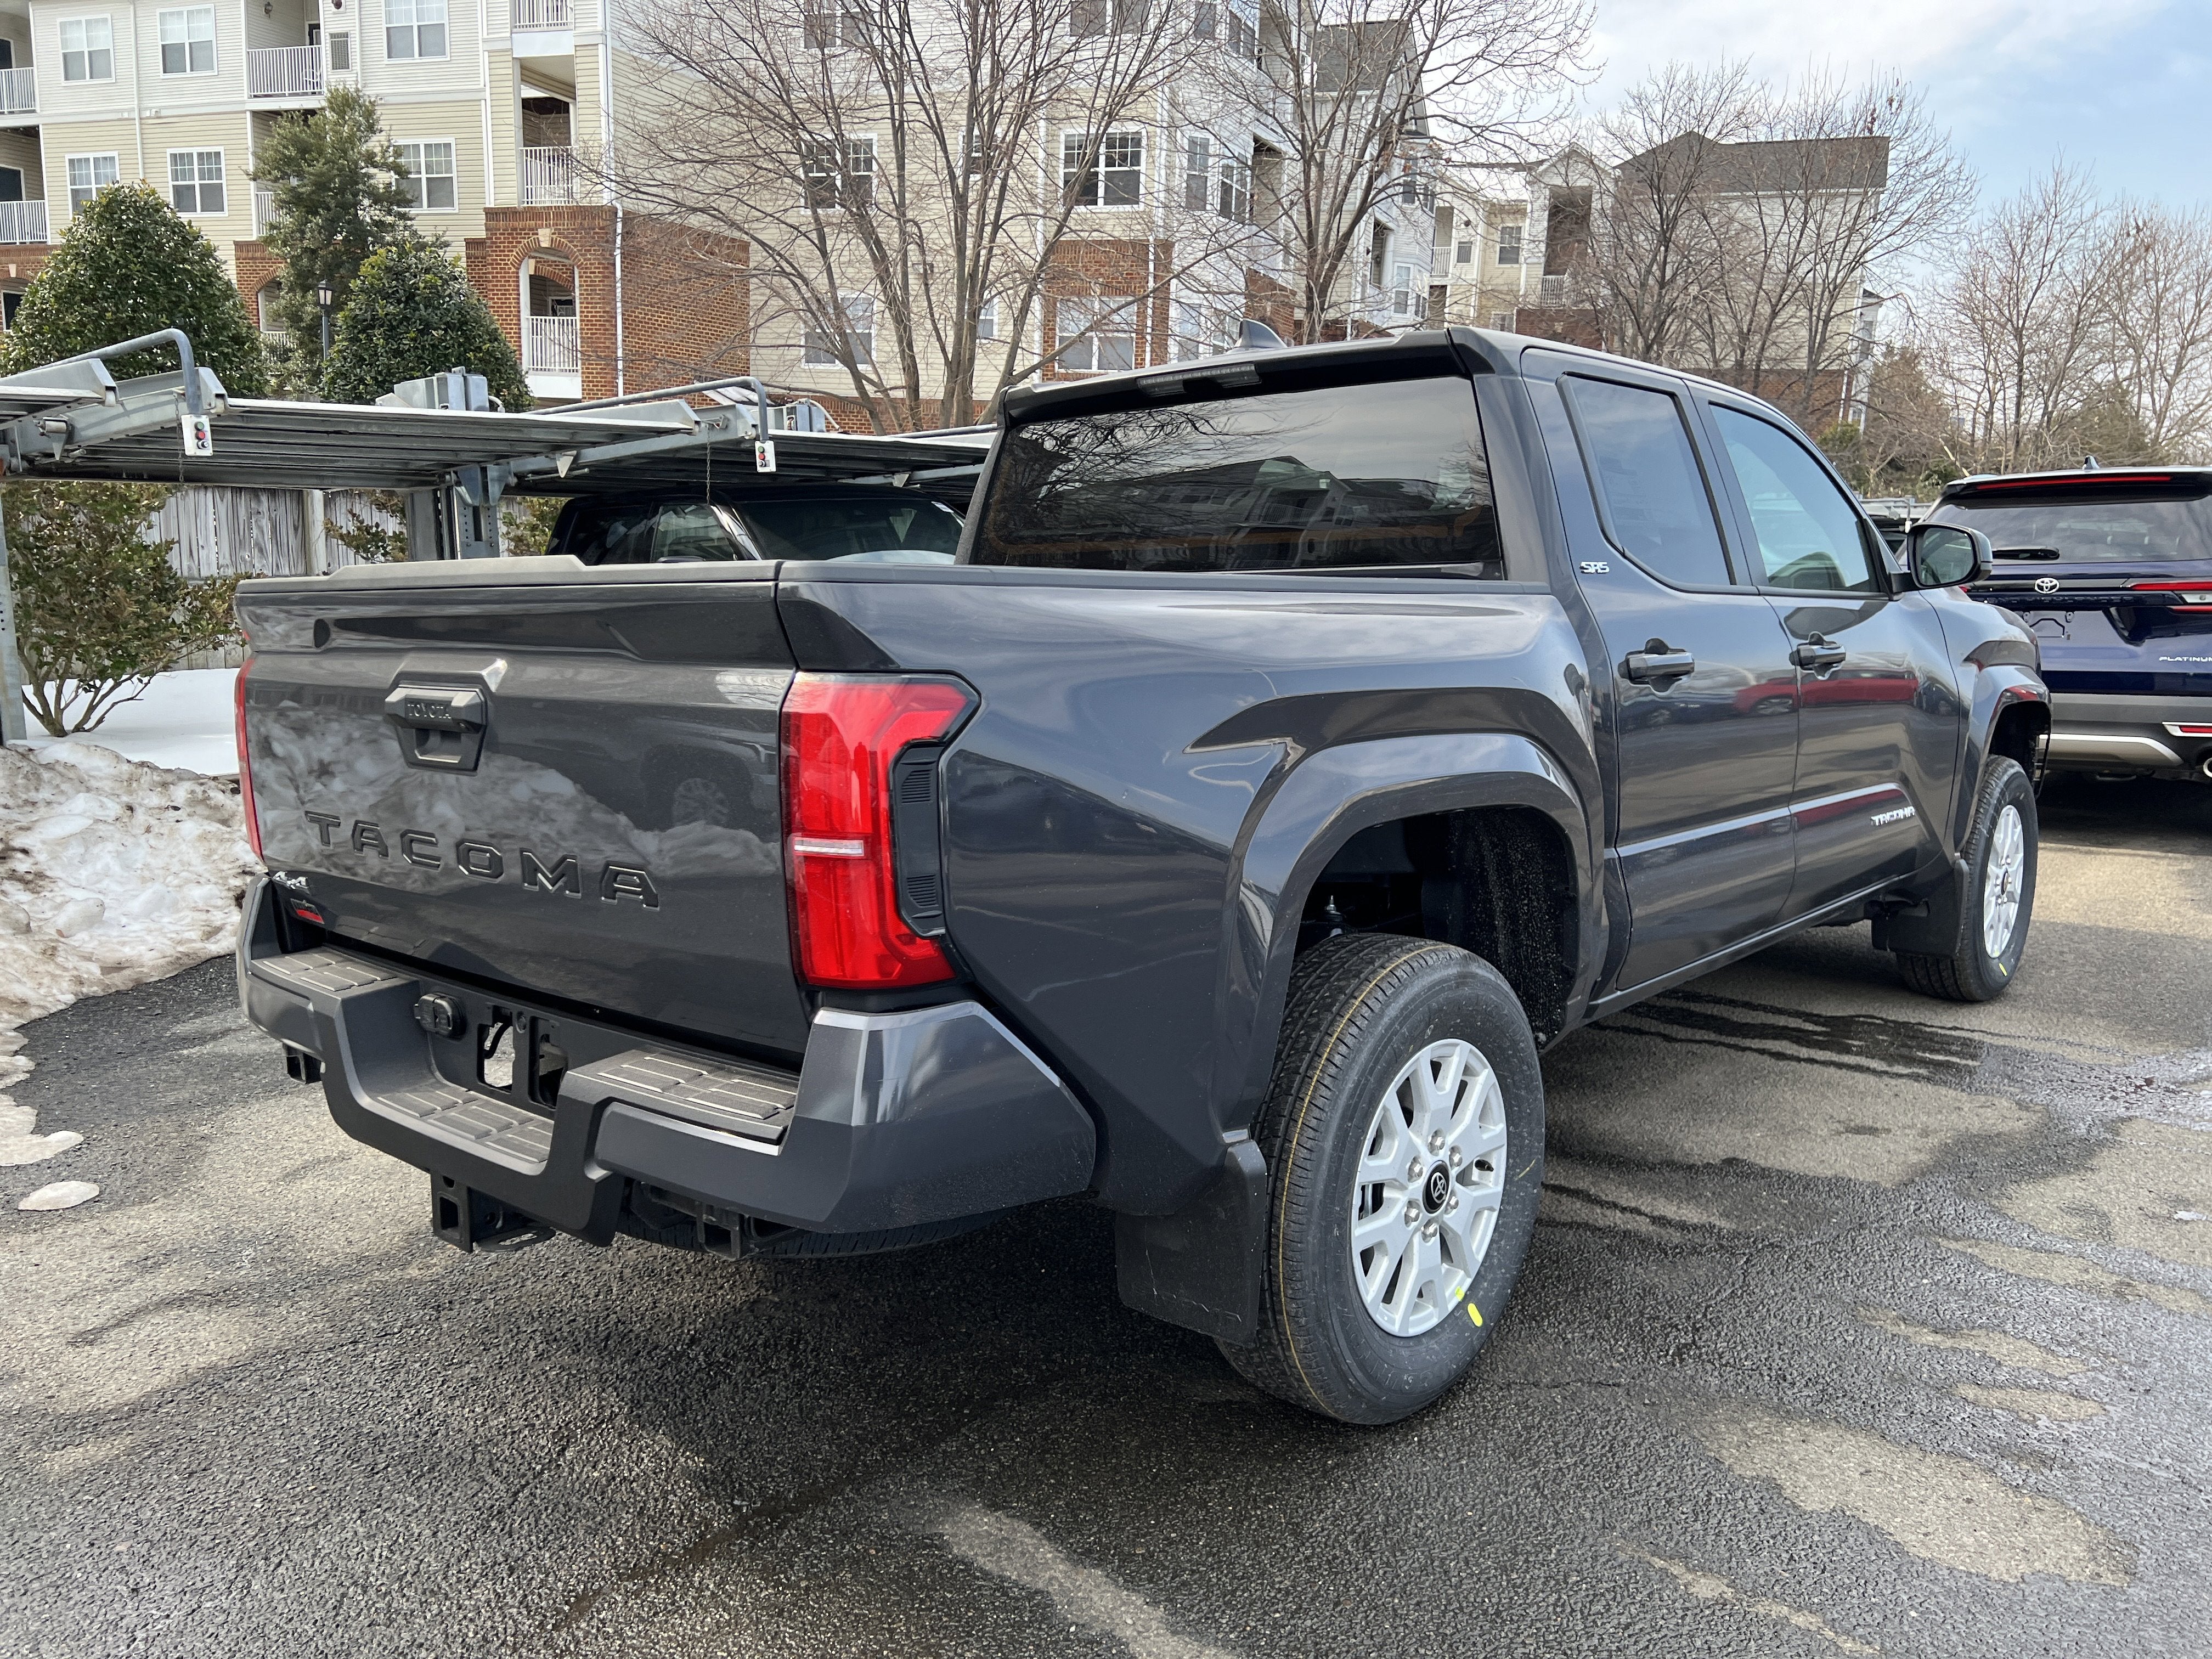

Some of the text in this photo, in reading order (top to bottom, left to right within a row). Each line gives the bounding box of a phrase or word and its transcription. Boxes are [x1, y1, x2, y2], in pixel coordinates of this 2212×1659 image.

[1580, 561, 1610, 573] SR5
[407, 703, 452, 719] TOYOTA
[1871, 806, 1916, 826] TACOMA
[305, 810, 660, 911] TACOMA
